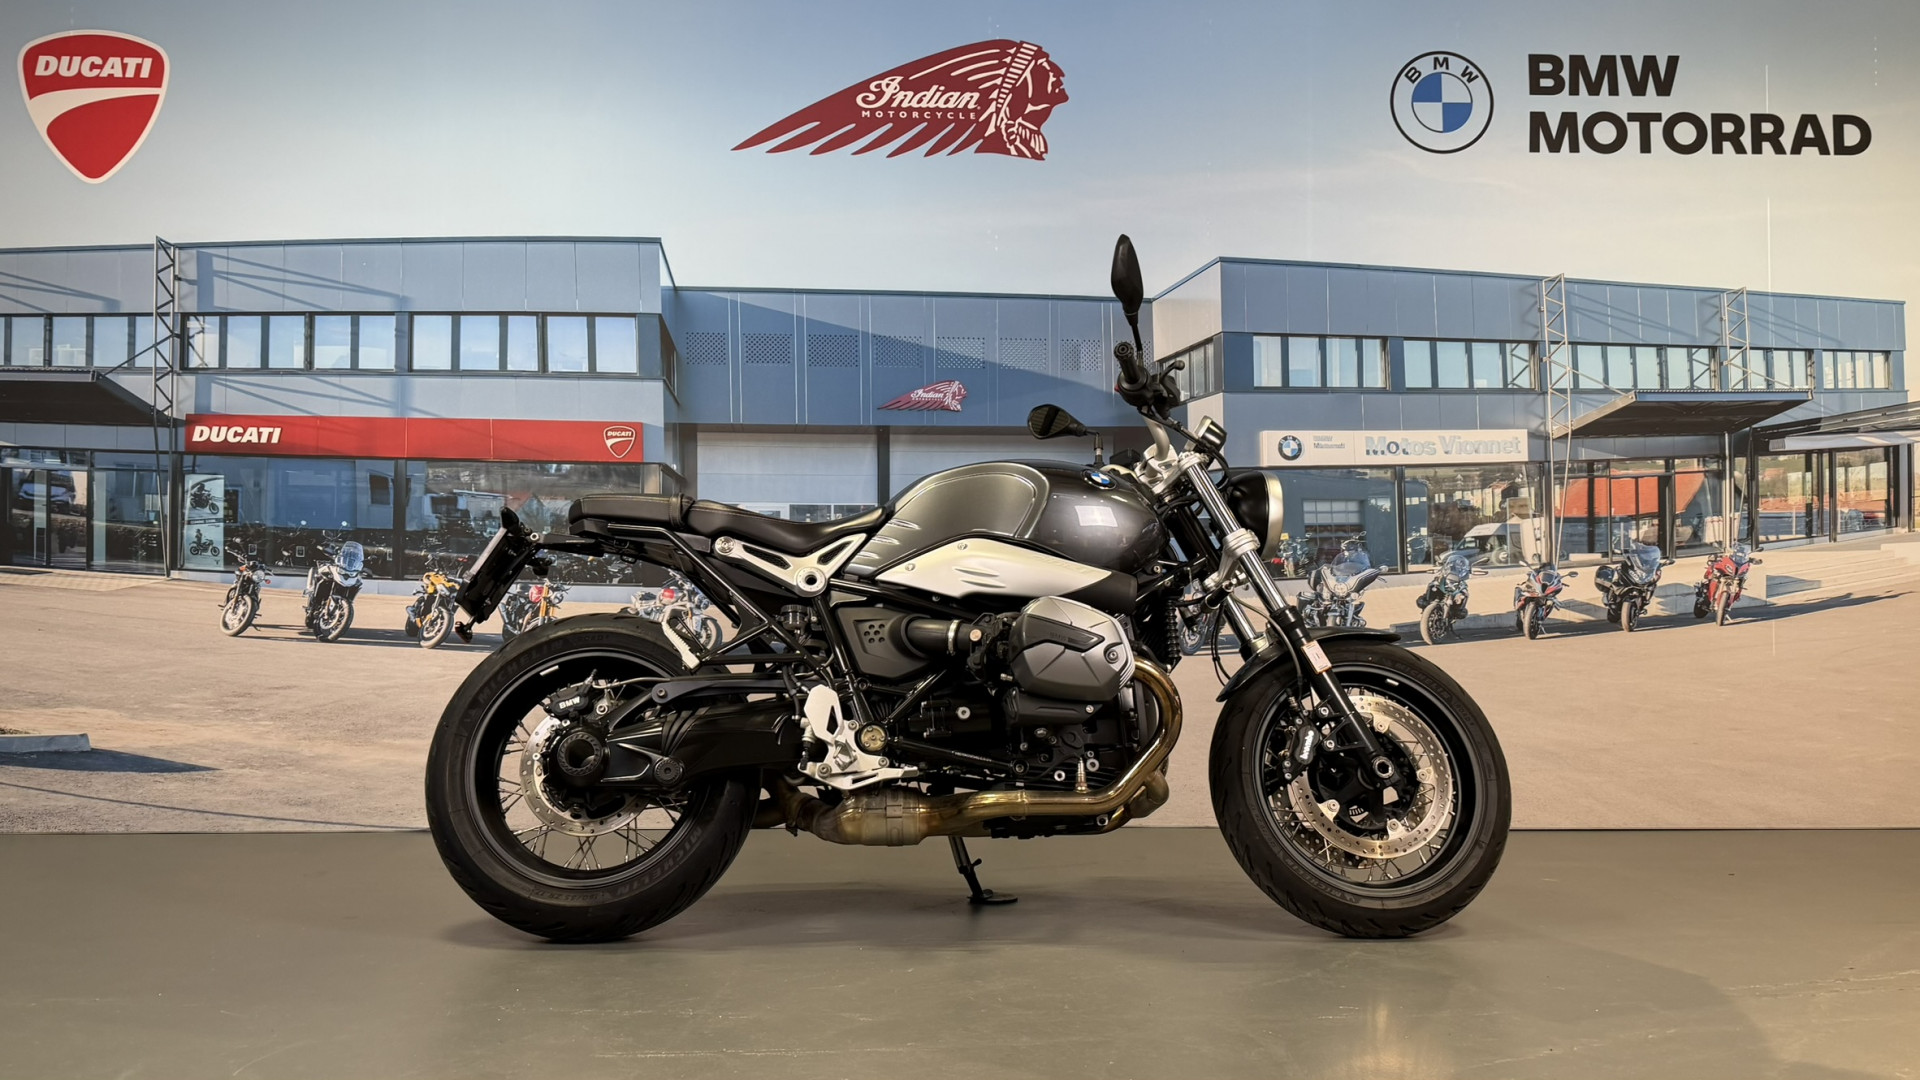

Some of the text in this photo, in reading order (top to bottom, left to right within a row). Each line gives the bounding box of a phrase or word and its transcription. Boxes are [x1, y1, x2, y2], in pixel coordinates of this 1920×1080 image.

[35, 54, 153, 79] DUCATI
[1404, 56, 1480, 84] BMW
[1528, 53, 1680, 97] BMW
[856, 76, 980, 109] Indian
[861, 110, 976, 119] MOTORCYCLE
[1528, 110, 1873, 156] MOTORRAD
[910, 388, 944, 399] Indian
[191, 425, 282, 444] DUCATI
[1365, 435, 1522, 456] Motos Vionnet
[477, 638, 565, 705] MICHELIN
[559, 696, 581, 710] BMW
[616, 825, 703, 896] MICHELIN
[1284, 858, 1342, 897] MICHELIN
